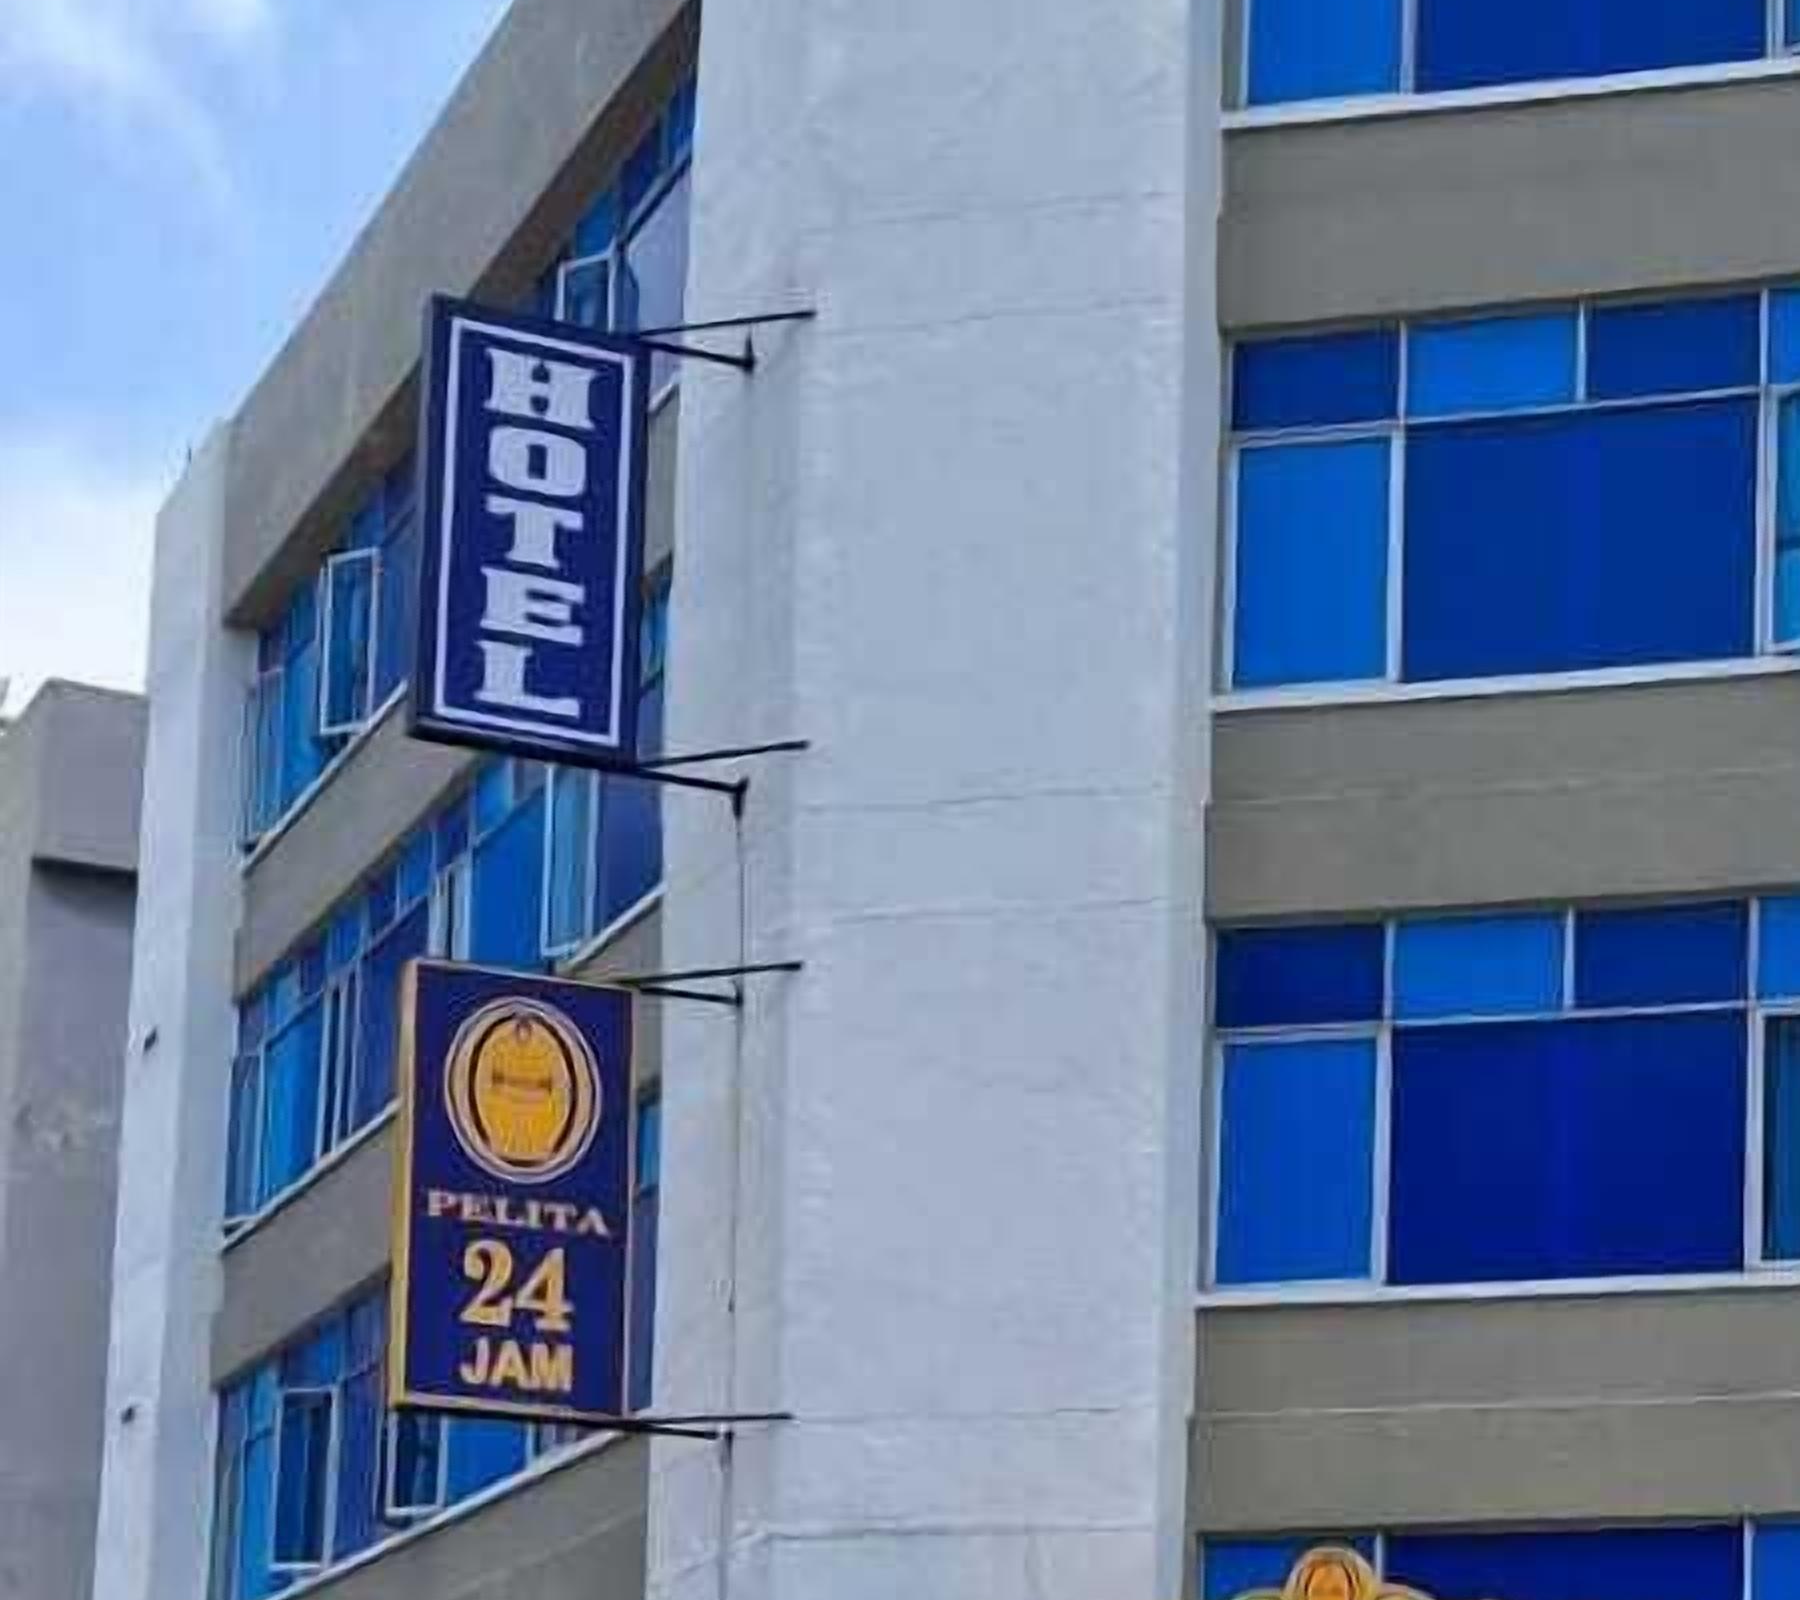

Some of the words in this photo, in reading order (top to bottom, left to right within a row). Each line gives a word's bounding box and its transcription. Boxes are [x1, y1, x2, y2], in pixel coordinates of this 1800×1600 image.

[475, 347, 597, 718] HOTEL
[427, 1190, 610, 1236] PELITA
[459, 1239, 575, 1333] 24
[460, 1339, 573, 1392] JAM
